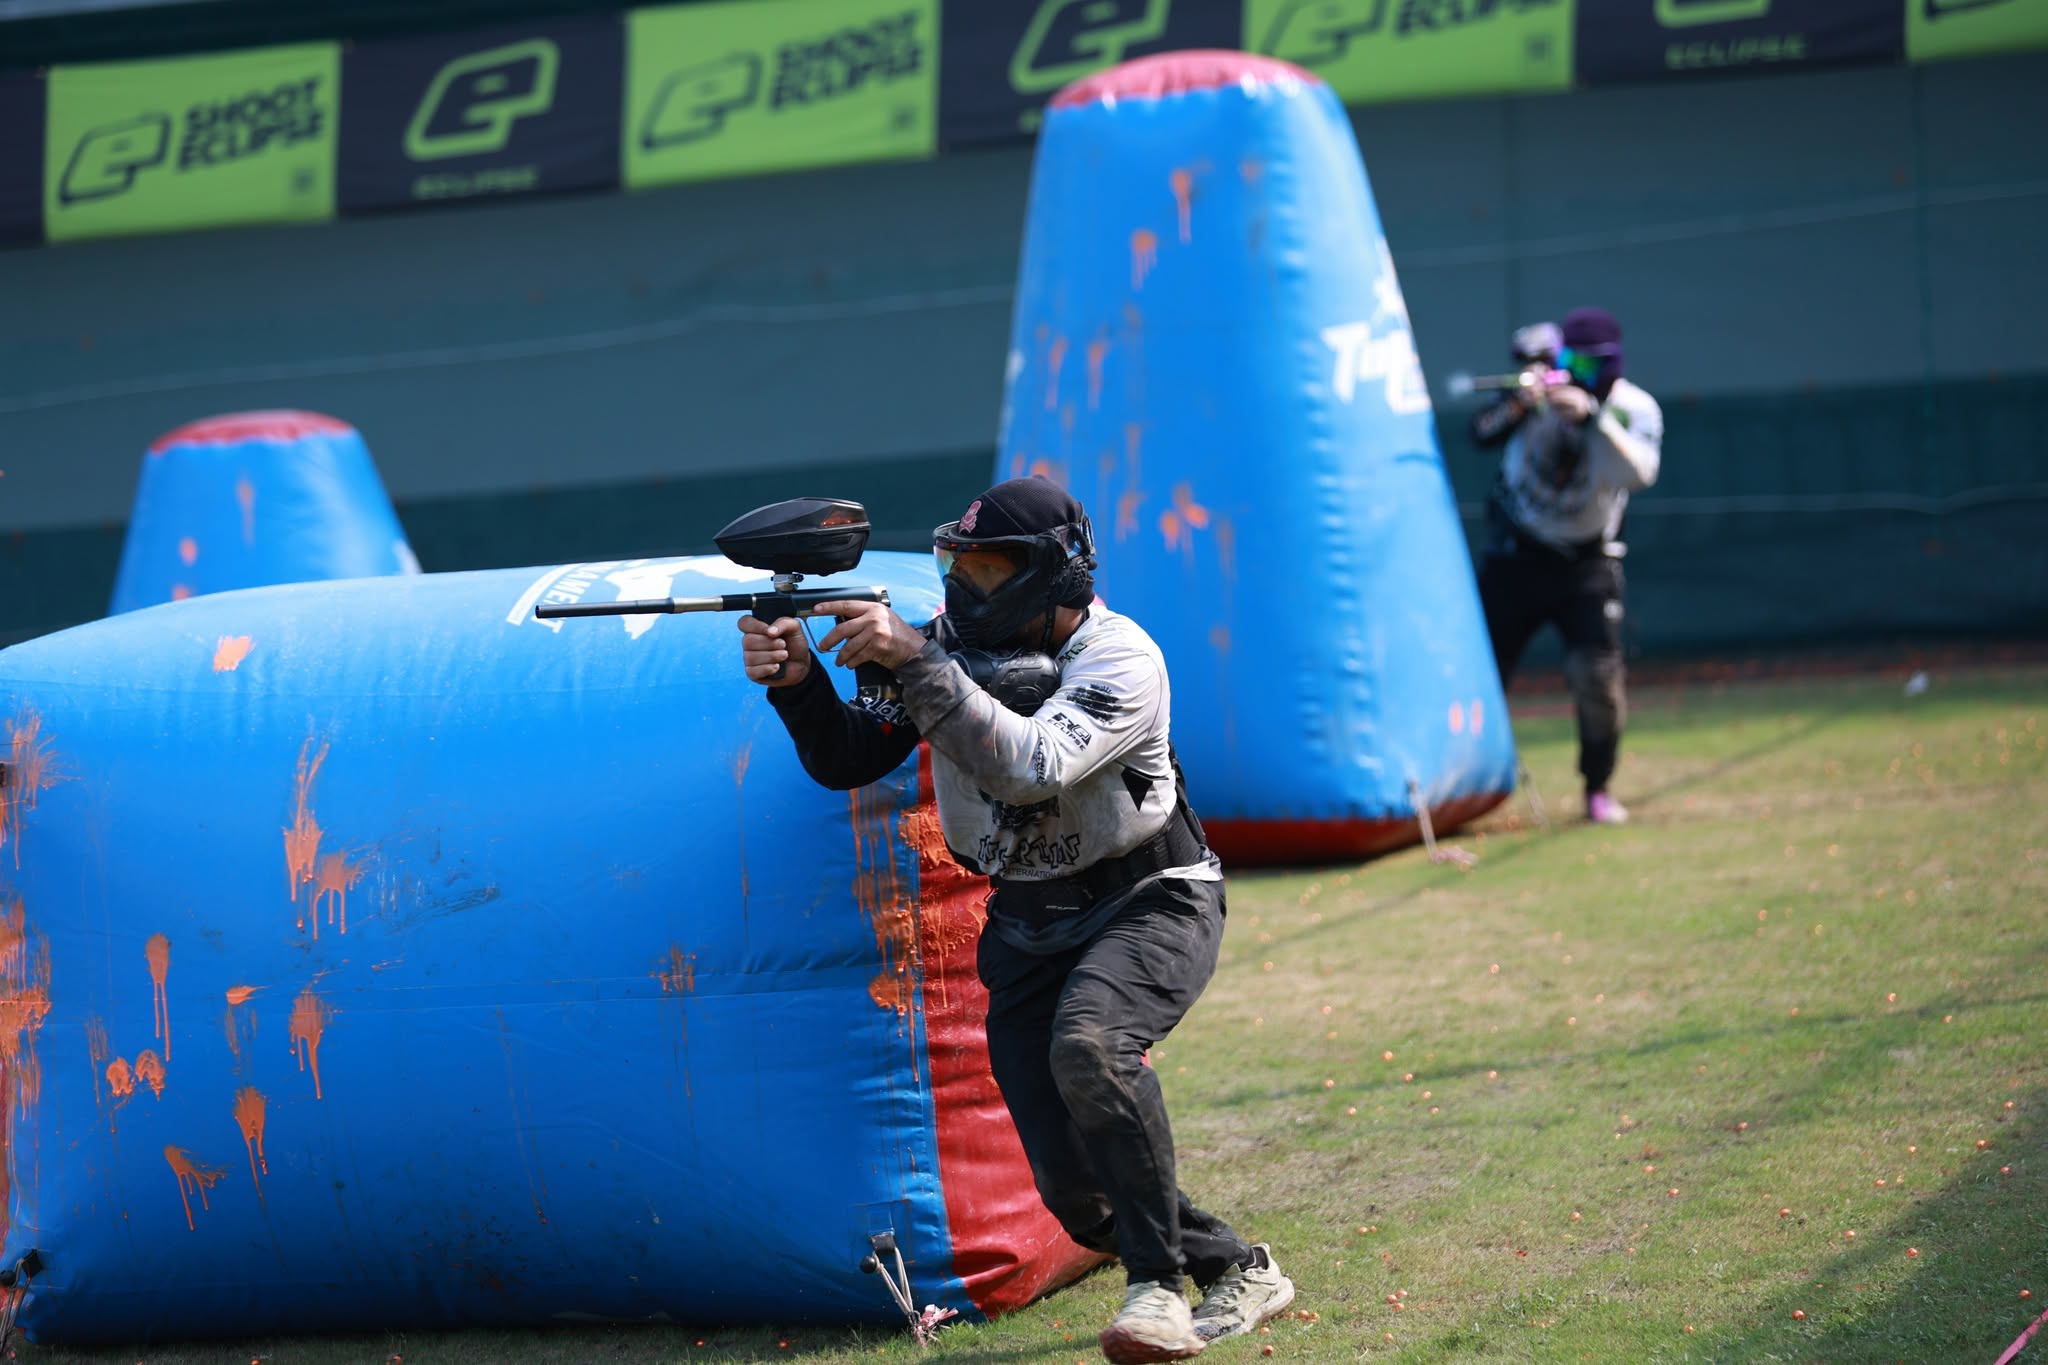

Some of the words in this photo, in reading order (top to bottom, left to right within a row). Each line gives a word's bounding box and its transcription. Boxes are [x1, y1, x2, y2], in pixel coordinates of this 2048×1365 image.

[777, 9, 921, 74] SHOOT
[1394, 0, 1560, 40] ECLIP
[767, 43, 920, 113] ECLIPSE
[1664, 33, 1806, 70] ECLIPSE
[185, 75, 325, 136] SHOOT
[175, 108, 324, 171] ECLIPSE
[1047, 718, 1087, 752] ECLIPSE
